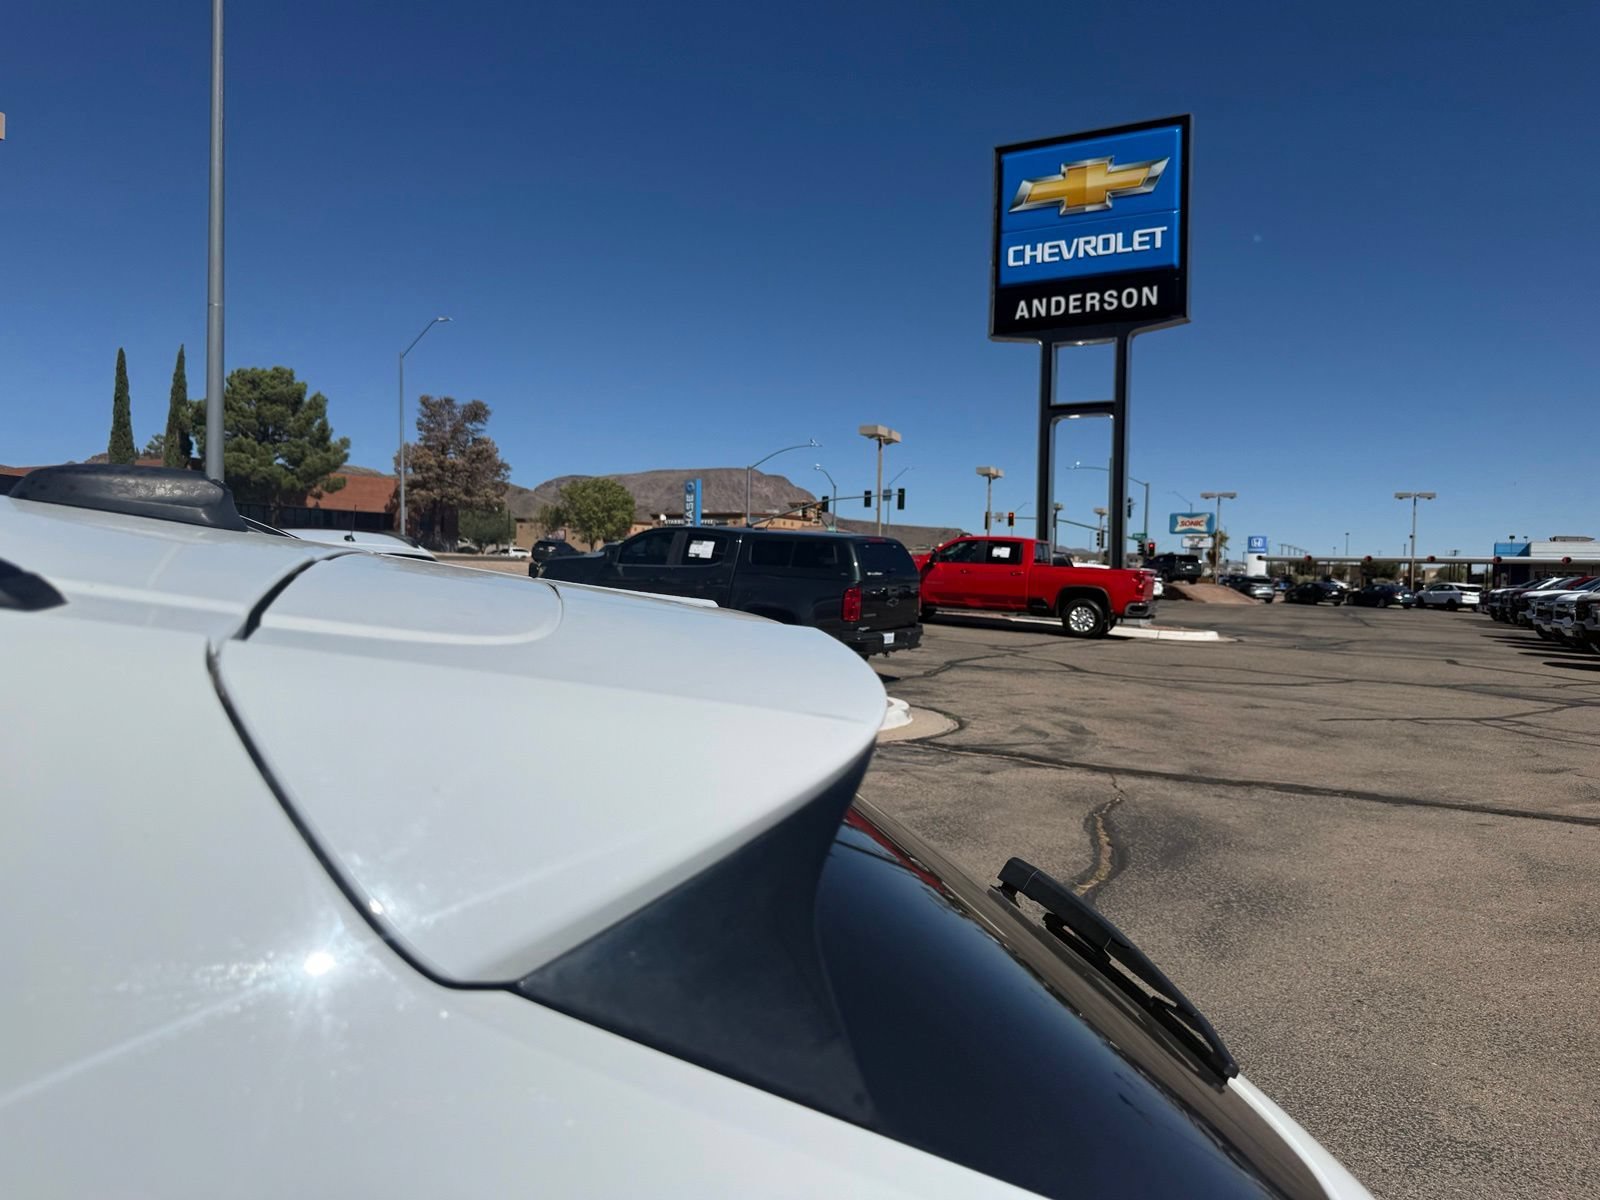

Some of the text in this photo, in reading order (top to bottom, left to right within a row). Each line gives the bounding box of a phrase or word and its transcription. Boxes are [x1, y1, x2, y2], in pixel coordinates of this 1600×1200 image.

[1007, 226, 1168, 267] CHEVROLET
[1014, 285, 1159, 320] ANDERSON
[685, 494, 694, 527] HASE
[1179, 519, 1204, 527] SONIC
